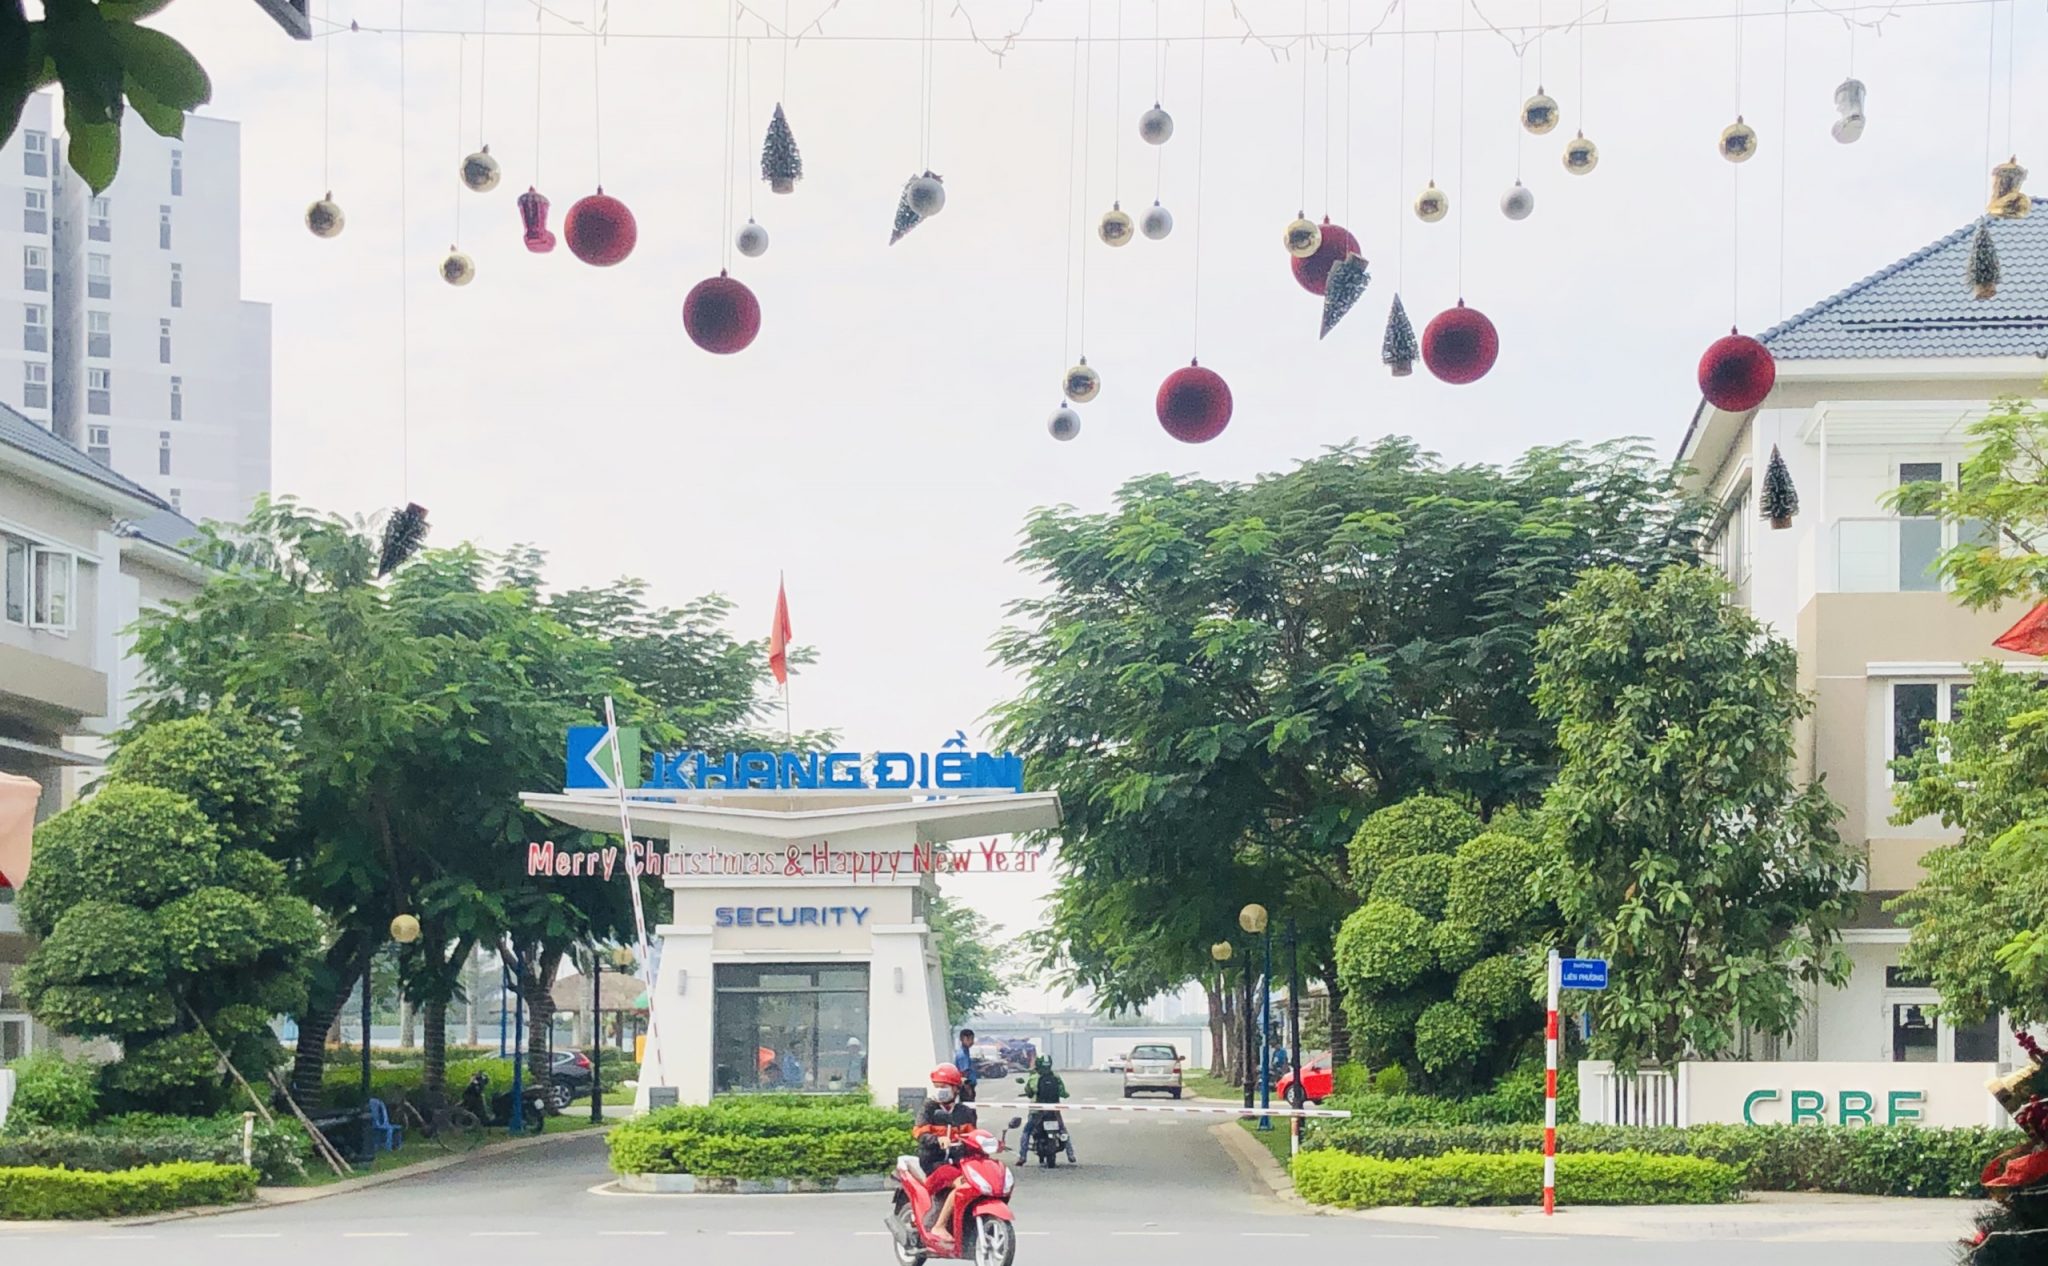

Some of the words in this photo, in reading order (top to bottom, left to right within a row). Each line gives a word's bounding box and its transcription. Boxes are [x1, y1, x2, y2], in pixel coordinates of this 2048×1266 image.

[651, 750, 864, 789] KHANG
[528, 841, 618, 881] Merry
[625, 840, 777, 876] Christmas
[784, 844, 805, 876] &
[812, 840, 902, 883] Happy
[912, 841, 972, 874] New
[978, 838, 1041, 873] Year
[715, 907, 870, 926] SECURITY
